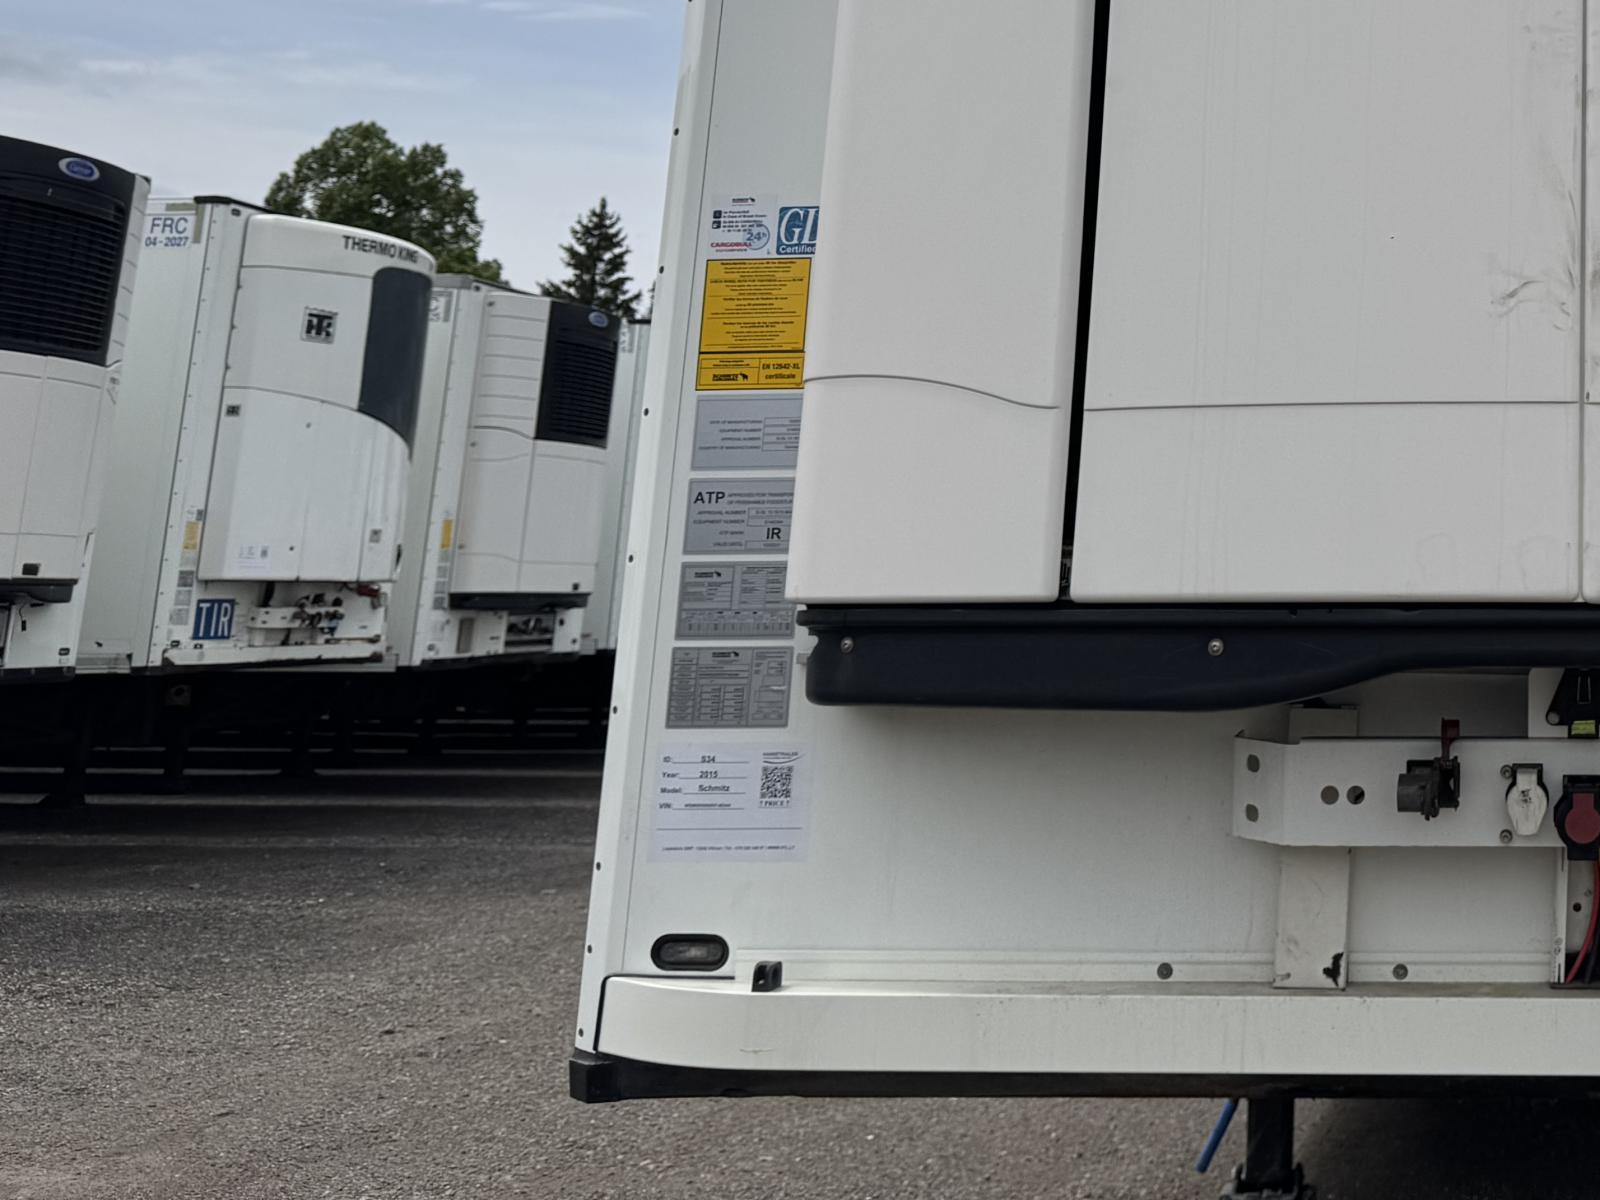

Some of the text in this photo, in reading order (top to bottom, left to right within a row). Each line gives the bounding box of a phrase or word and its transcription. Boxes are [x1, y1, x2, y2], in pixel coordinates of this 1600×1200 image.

[150, 216, 189, 235] FRC
[145, 236, 189, 247] 04-2027
[342, 234, 398, 259] THERMO
[693, 491, 726, 504] ATP
[766, 527, 782, 540] IR
[200, 603, 232, 637] TIR
[698, 784, 730, 792] Schmitz
